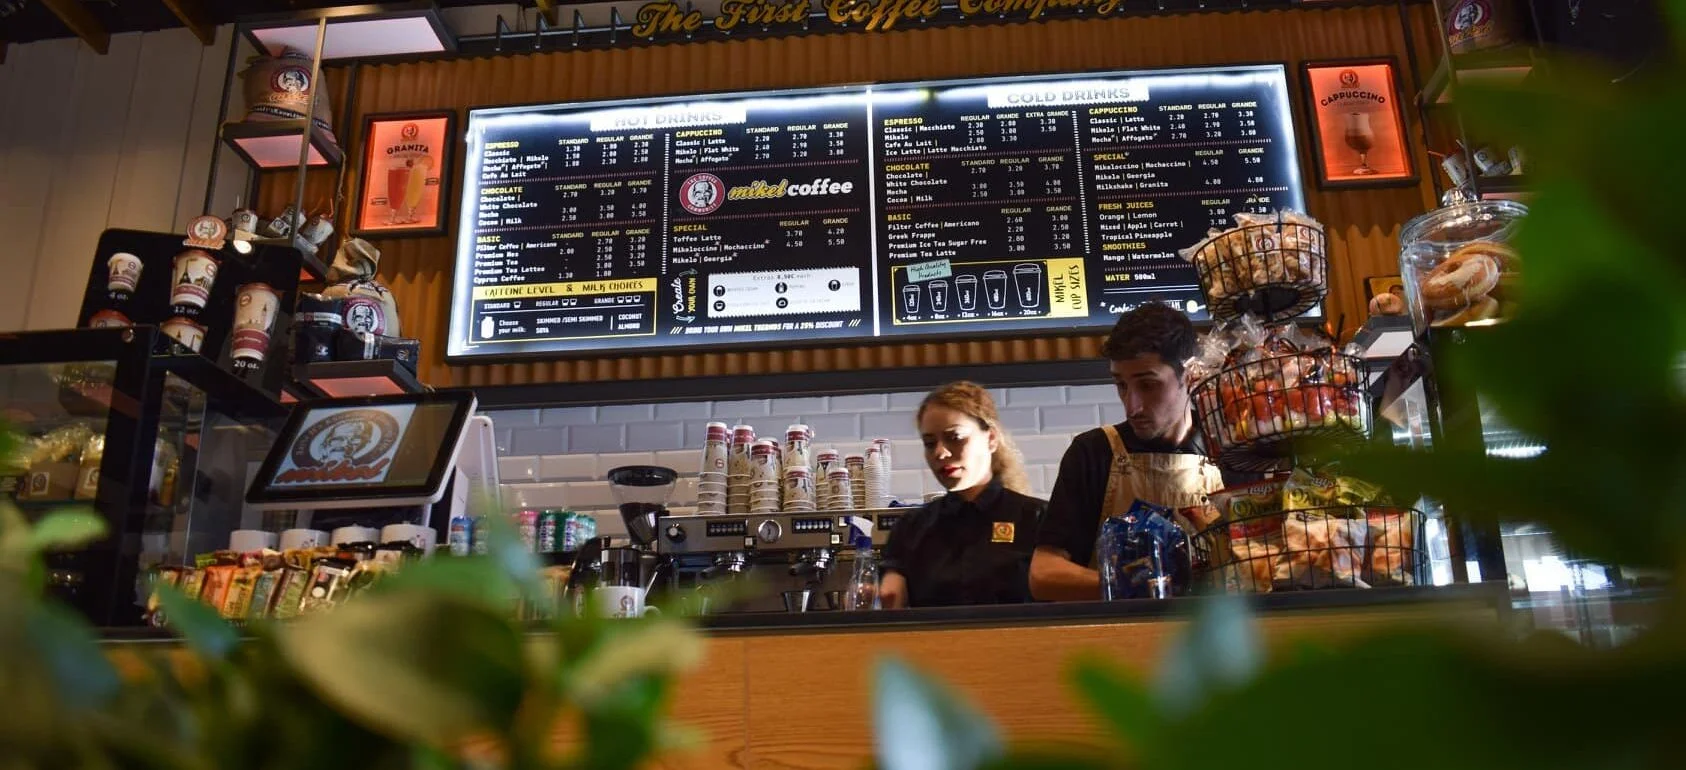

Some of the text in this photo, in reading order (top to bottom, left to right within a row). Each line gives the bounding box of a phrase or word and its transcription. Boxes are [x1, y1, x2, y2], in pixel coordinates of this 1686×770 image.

[632, 2, 702, 37] The
[715, 0, 809, 30] First
[824, 0, 940, 31] Coffee
[1007, 88, 1130, 103] COLD DRINKS
[1320, 91, 1386, 106] CAPPUCCINO
[1089, 106, 1138, 115] CAPPUCCINO
[615, 111, 722, 127] HOT DRINKS
[676, 129, 723, 137] CAPPUCCINO
[387, 145, 429, 154] GRANITA
[886, 163, 930, 172] CHOCOLATE
[728, 178, 853, 200] mikel coffee
[673, 224, 708, 232] SPECIAL
[944, 220, 980, 228] Americano
[1102, 233, 1133, 241] Tropical
[1103, 242, 1146, 251] SMOOTHIES
[1132, 252, 1174, 260] Watermelon
[925, 262, 947, 270] Quality
[485, 281, 643, 296] CAFFEINE LEVEL & MILK CHOICES
[688, 278, 696, 294] OWN
[1053, 273, 1066, 303] MIKEL
[1068, 264, 1082, 310] CUP SIZES
[671, 278, 684, 314] Create
[234, 359, 246, 367] 20
